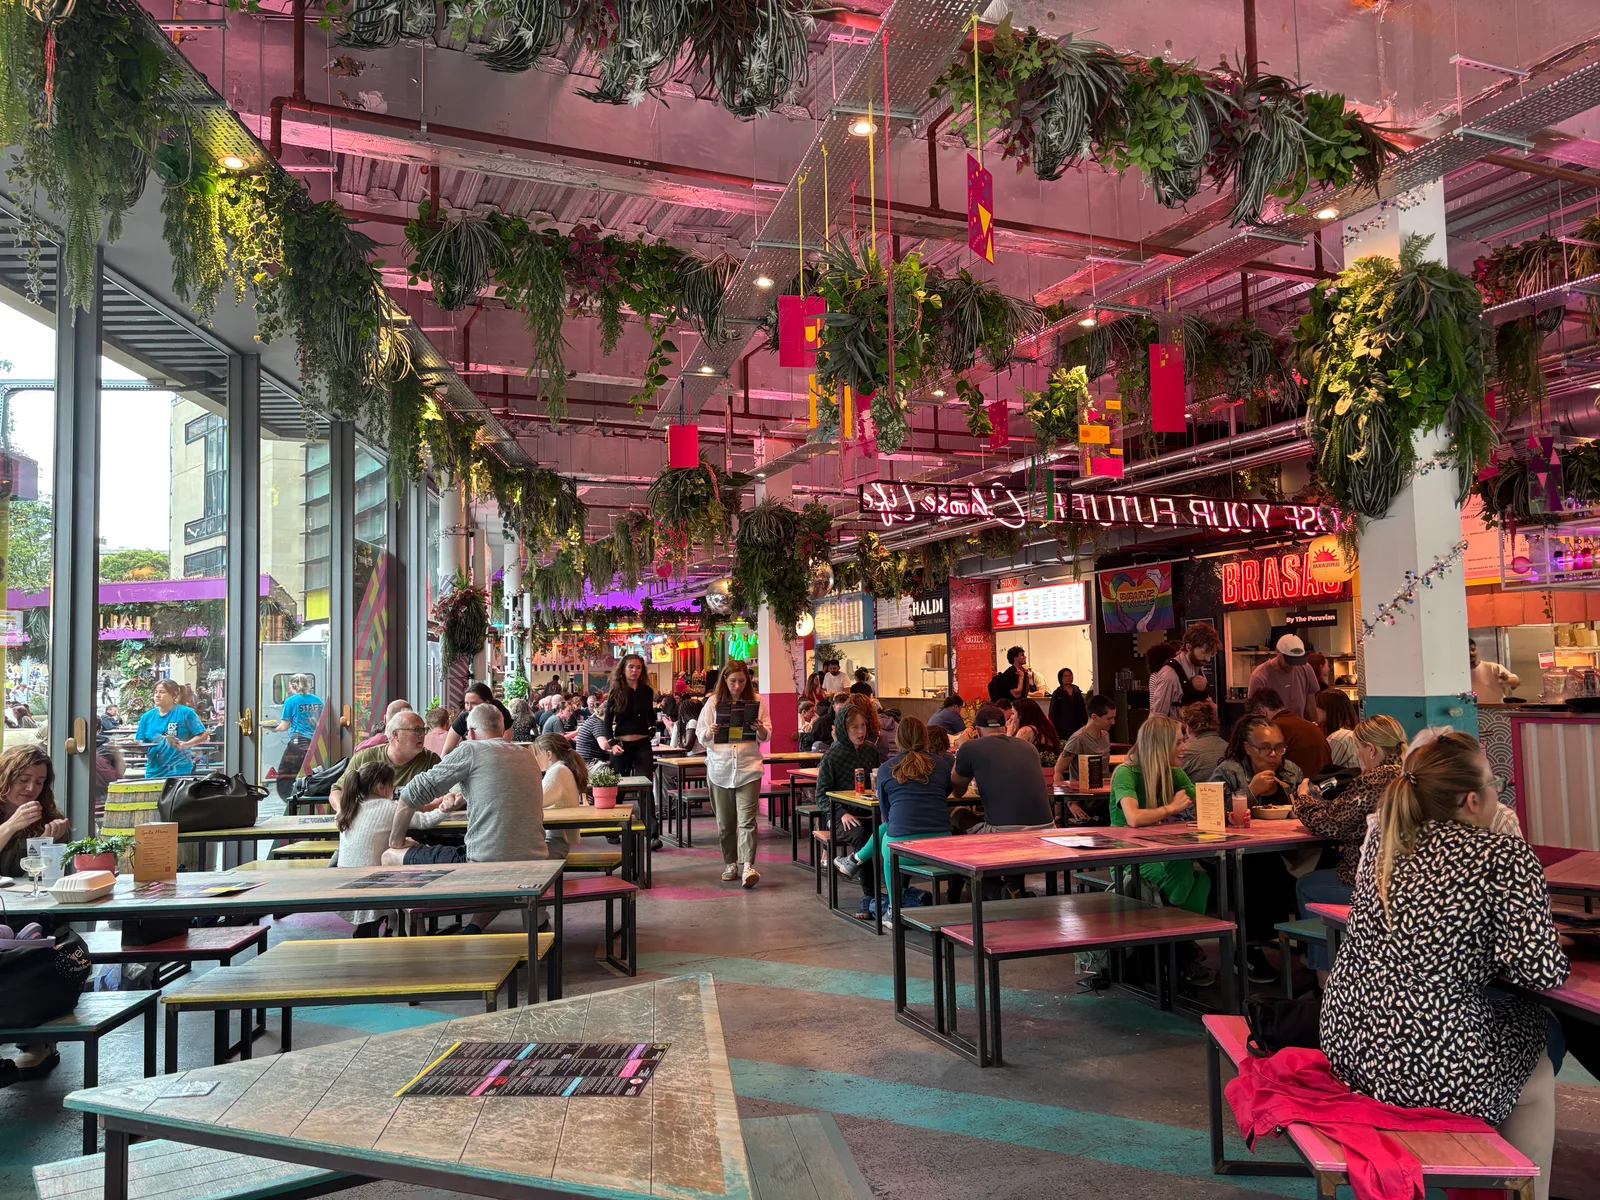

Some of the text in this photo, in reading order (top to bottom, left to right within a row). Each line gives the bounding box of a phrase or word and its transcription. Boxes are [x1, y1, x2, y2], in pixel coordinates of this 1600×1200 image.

[1119, 589, 1156, 608] PRIDE
[912, 598, 943, 616] HALDI
[1308, 614, 1336, 622] Peruvian
[298, 703, 322, 712] STAFF
